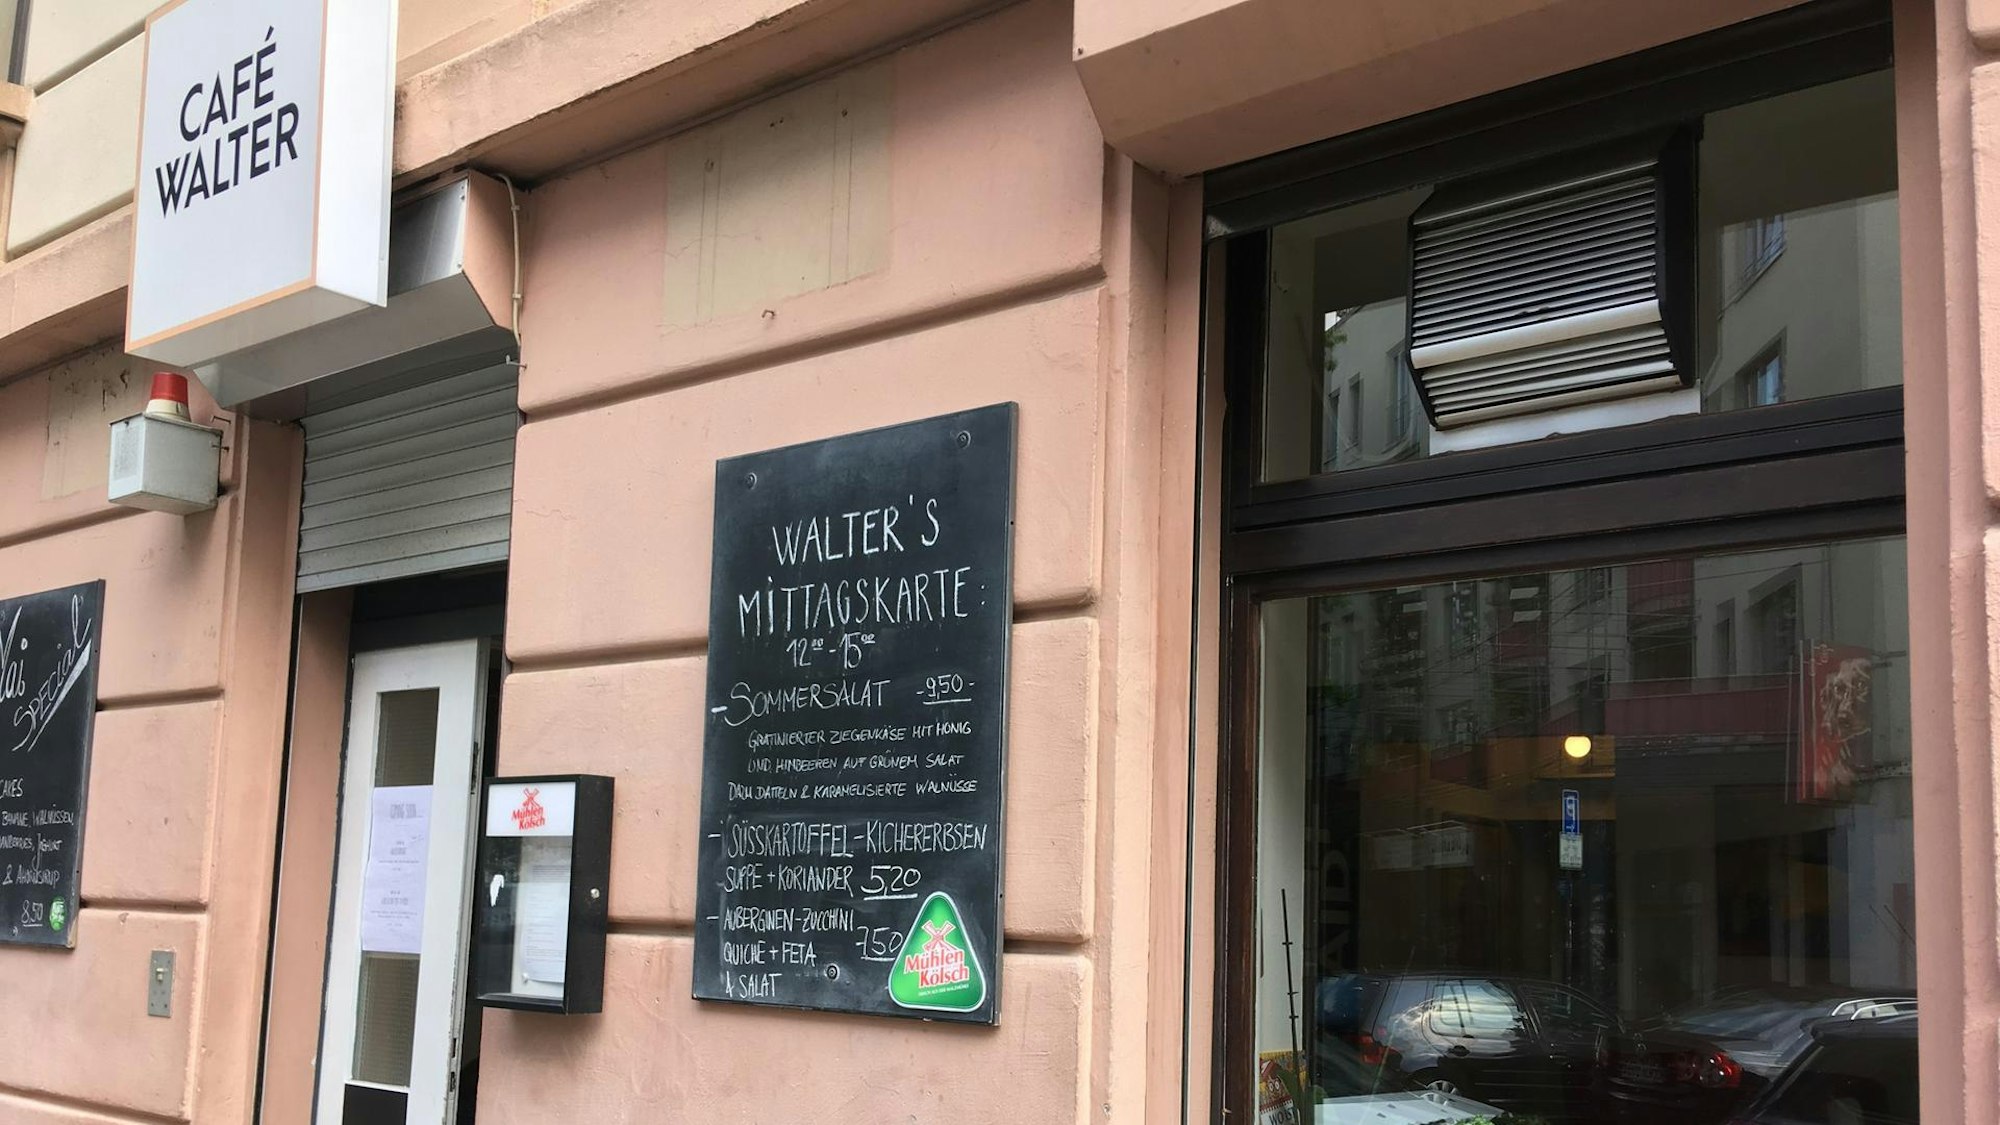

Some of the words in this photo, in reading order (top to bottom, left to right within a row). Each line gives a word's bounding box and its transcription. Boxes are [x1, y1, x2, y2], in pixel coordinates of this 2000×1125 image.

[179, 25, 277, 142] CAFÉ
[155, 102, 299, 219] WALTER
[772, 494, 940, 566] WALTER'S
[748, 729, 826, 752] GRATINIERTER
[829, 724, 907, 744] ZIEGENKÄSE
[936, 721, 972, 737] HONIG
[747, 757, 772, 774] UND
[843, 757, 867, 769] AUF
[869, 750, 919, 769] GRÜNEM
[925, 753, 965, 768] SALAT
[755, 785, 798, 800] DATTELN
[800, 785, 811, 799] &
[915, 773, 978, 796] WALNÜSSE
[723, 862, 764, 893] SUPPE
[778, 864, 854, 897] KORIANDER
[723, 940, 766, 966] QUICHE
[782, 941, 817, 968] FETA
[903, 947, 964, 973] Mühlen
[738, 973, 784, 999] SALAT
[920, 965, 969, 988] Kölsch
